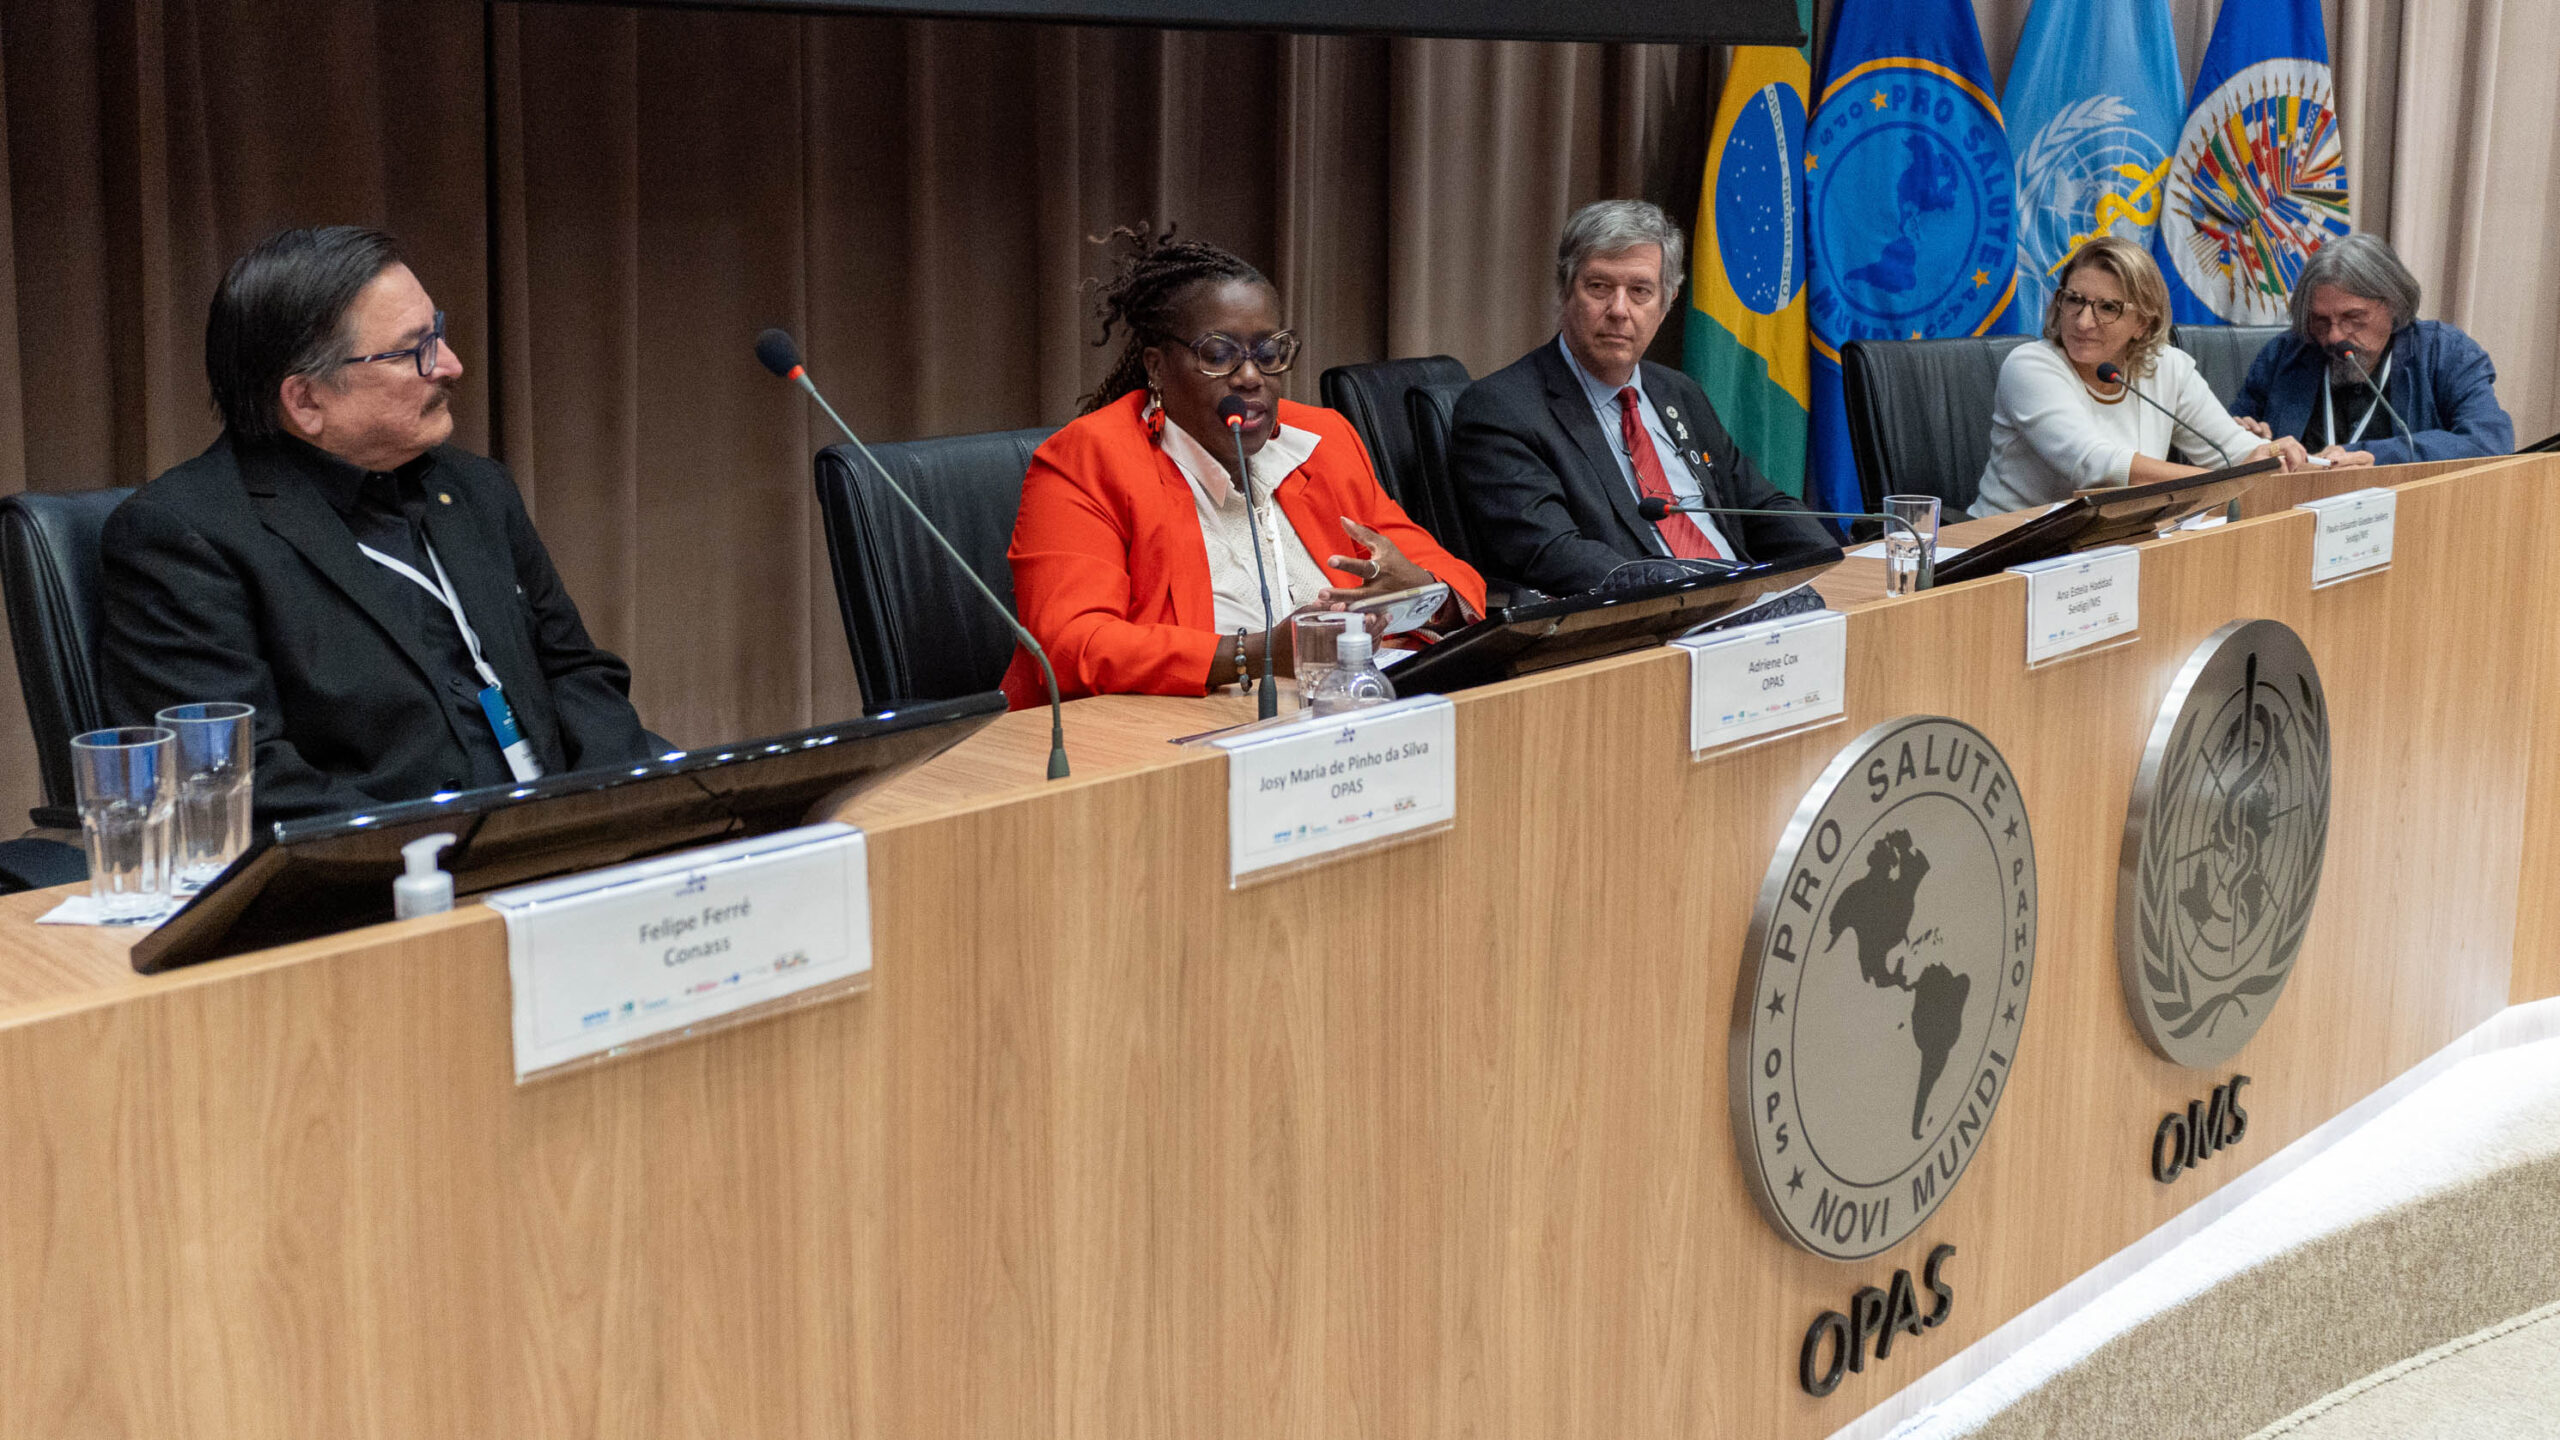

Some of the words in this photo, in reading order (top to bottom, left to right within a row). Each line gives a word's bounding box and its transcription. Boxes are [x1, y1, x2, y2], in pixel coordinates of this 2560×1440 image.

[1820, 101, 1863, 146] OPS
[1892, 84, 1954, 124] PRO
[1963, 125, 2010, 267] SALUTE
[1748, 656, 1781, 674] Adriene
[1784, 653, 1799, 666] Cox
[1762, 675, 1785, 691] OPAS
[1259, 775, 1287, 792] Josy
[1290, 764, 1326, 785] Maria
[1329, 760, 1345, 776] de
[1348, 752, 1382, 772] Pinho
[1385, 748, 1400, 763] da
[1402, 741, 1430, 759] Silva
[1331, 778, 1364, 799] OPAS
[1773, 819, 1842, 964] PRO
[1867, 735, 2007, 819] SALUTE
[639, 914, 697, 944] Felipe
[702, 897, 752, 927] Ferré
[663, 936, 732, 967] Conass
[2011, 858, 2029, 988] PAHO
[1764, 1048, 1789, 1155] OPS
[2152, 1075, 2252, 1184] OMS
[1810, 1187, 1891, 1244] NOVI
[1912, 1050, 2007, 1215] MUNDI
[1800, 1244, 1957, 1398] OPAS
